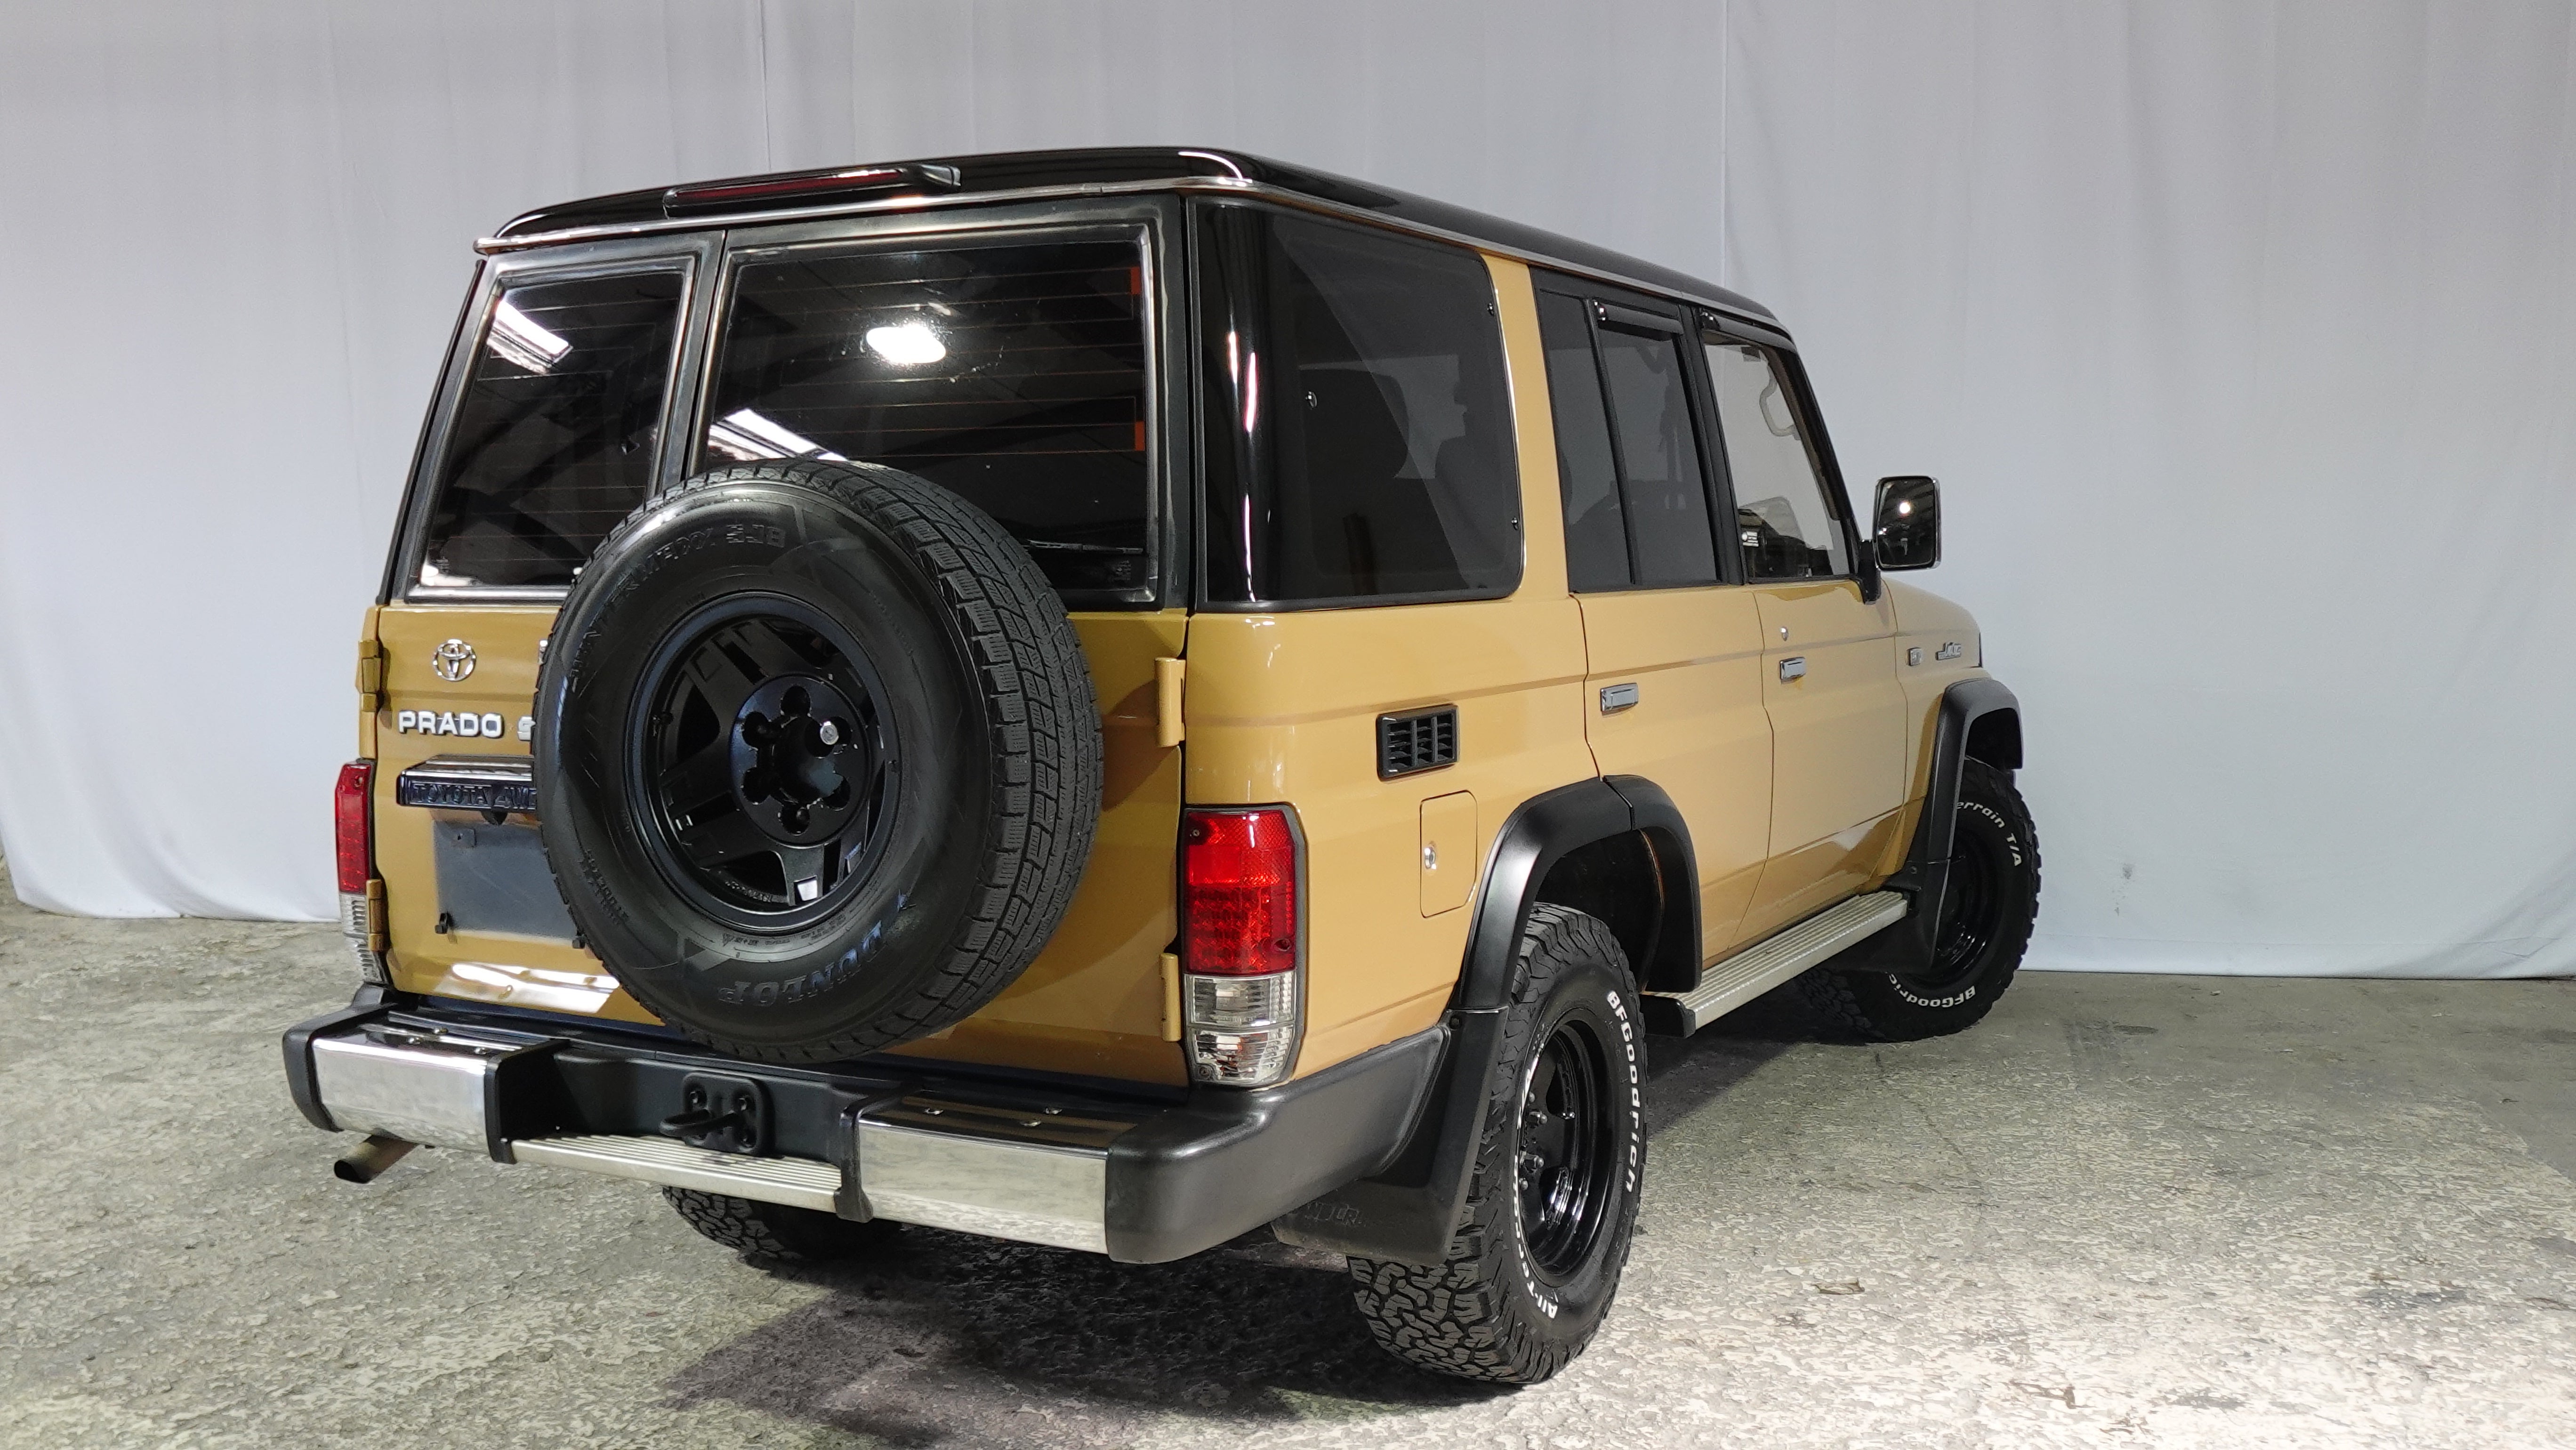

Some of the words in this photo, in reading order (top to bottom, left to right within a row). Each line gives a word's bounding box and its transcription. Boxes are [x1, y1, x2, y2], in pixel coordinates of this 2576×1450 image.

[399, 710, 505, 739] PRADO
[412, 782, 491, 807] TOYOTA
[1956, 801, 2006, 829] errain
[2006, 832, 2022, 867] T/A
[717, 919, 887, 1007] DUNLOP
[1888, 972, 1976, 1008] BFGoodric
[1606, 990, 1640, 1193] BFGoodrich
